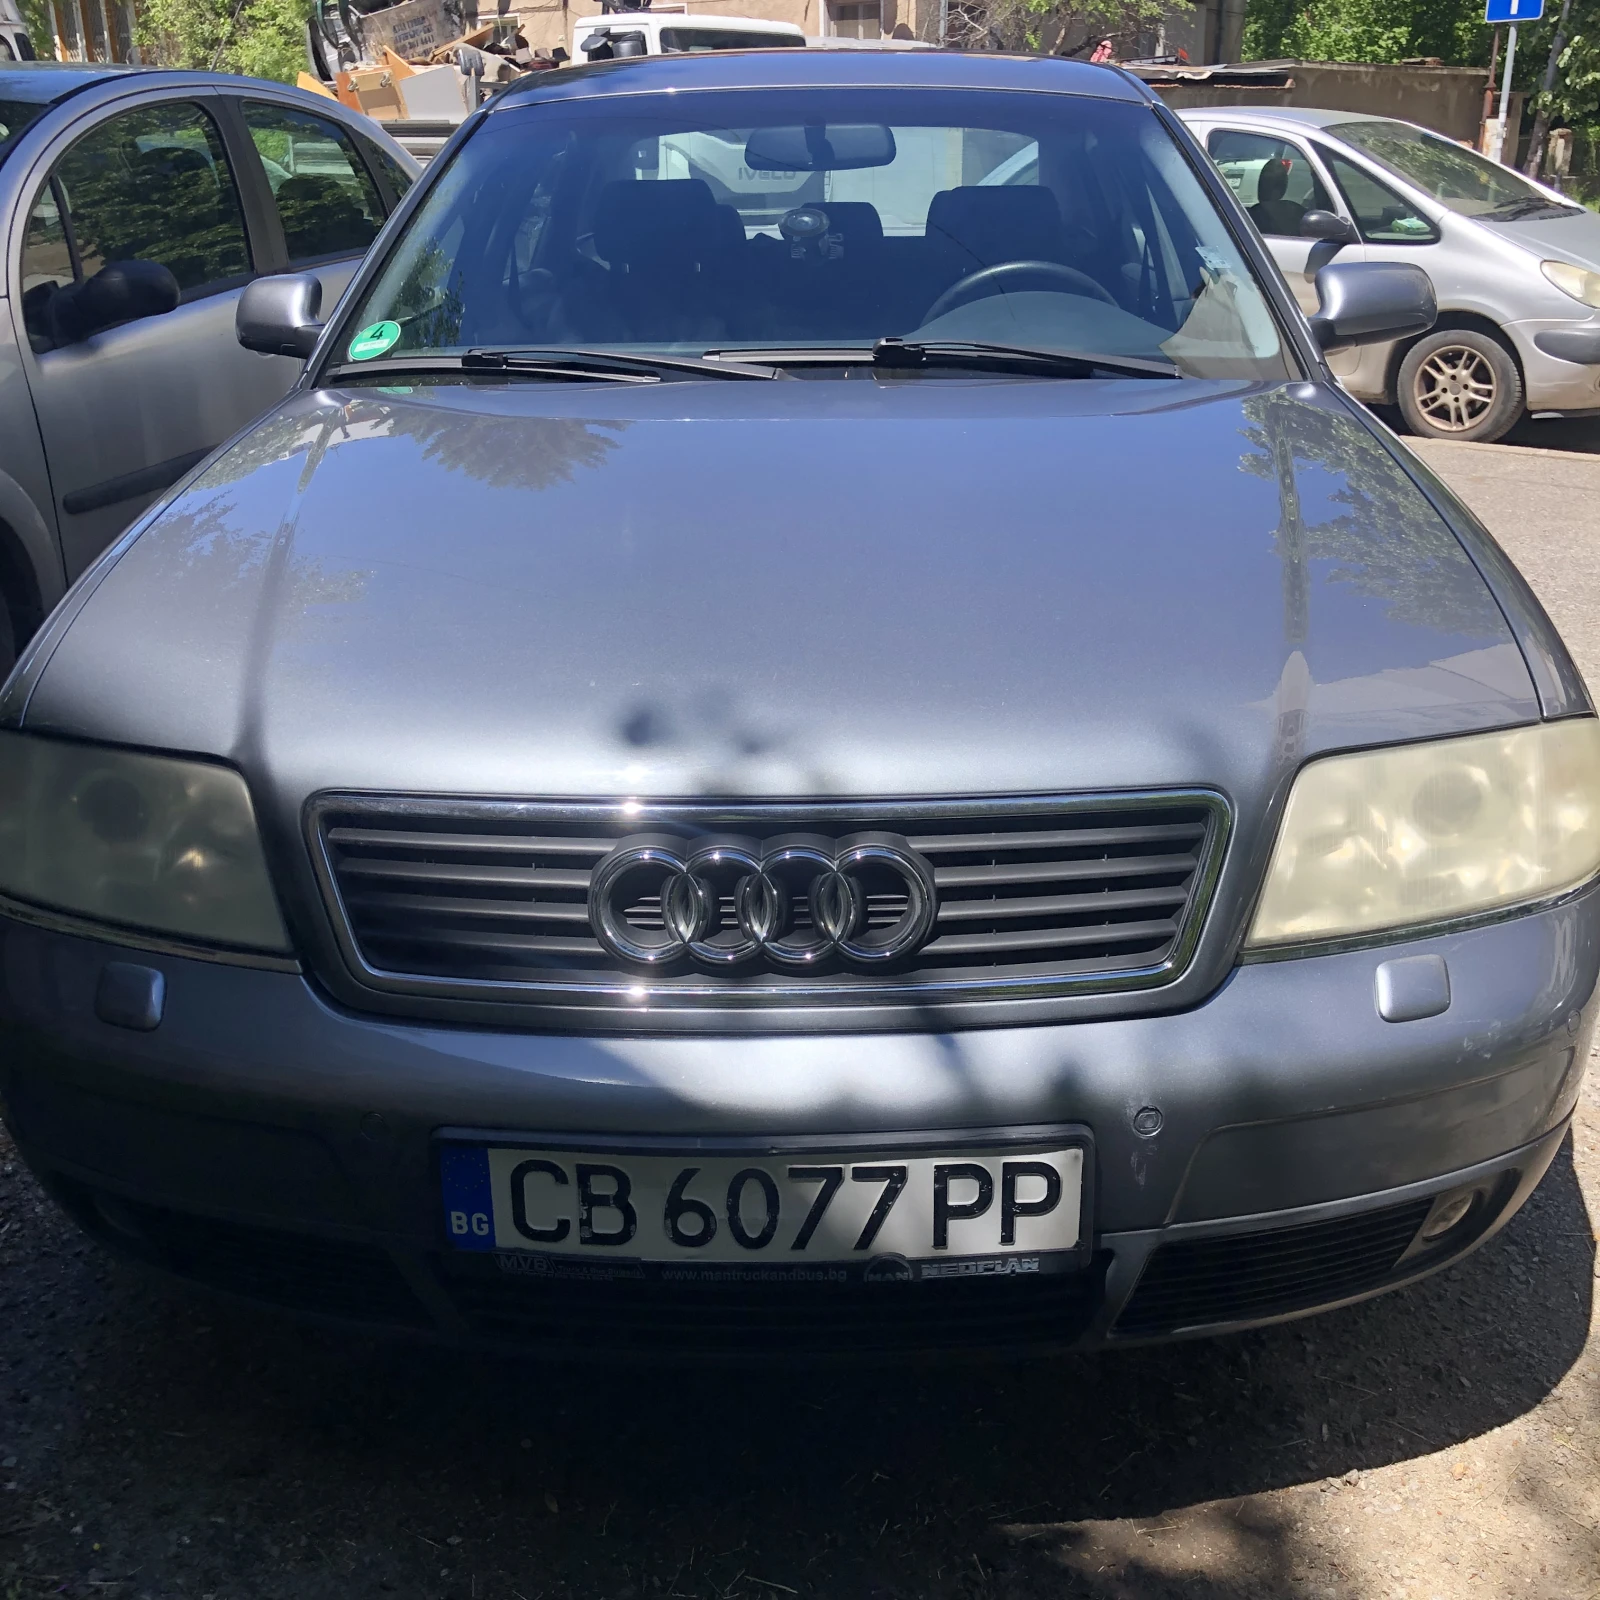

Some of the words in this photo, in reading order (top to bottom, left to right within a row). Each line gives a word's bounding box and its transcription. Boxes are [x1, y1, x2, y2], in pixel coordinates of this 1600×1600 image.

[738, 167, 797, 181] IVECO
[370, 324, 385, 340] 4
[511, 1159, 637, 1246] CB
[664, 1166, 909, 1250] 6077
[932, 1161, 1063, 1250] PP
[451, 1211, 490, 1236] BG
[499, 1255, 548, 1271] MVB
[921, 1258, 1040, 1278] NEOPLAN
[661, 1268, 848, 1283] www.mantruckandbus.bg
[867, 1272, 909, 1283] MAN
